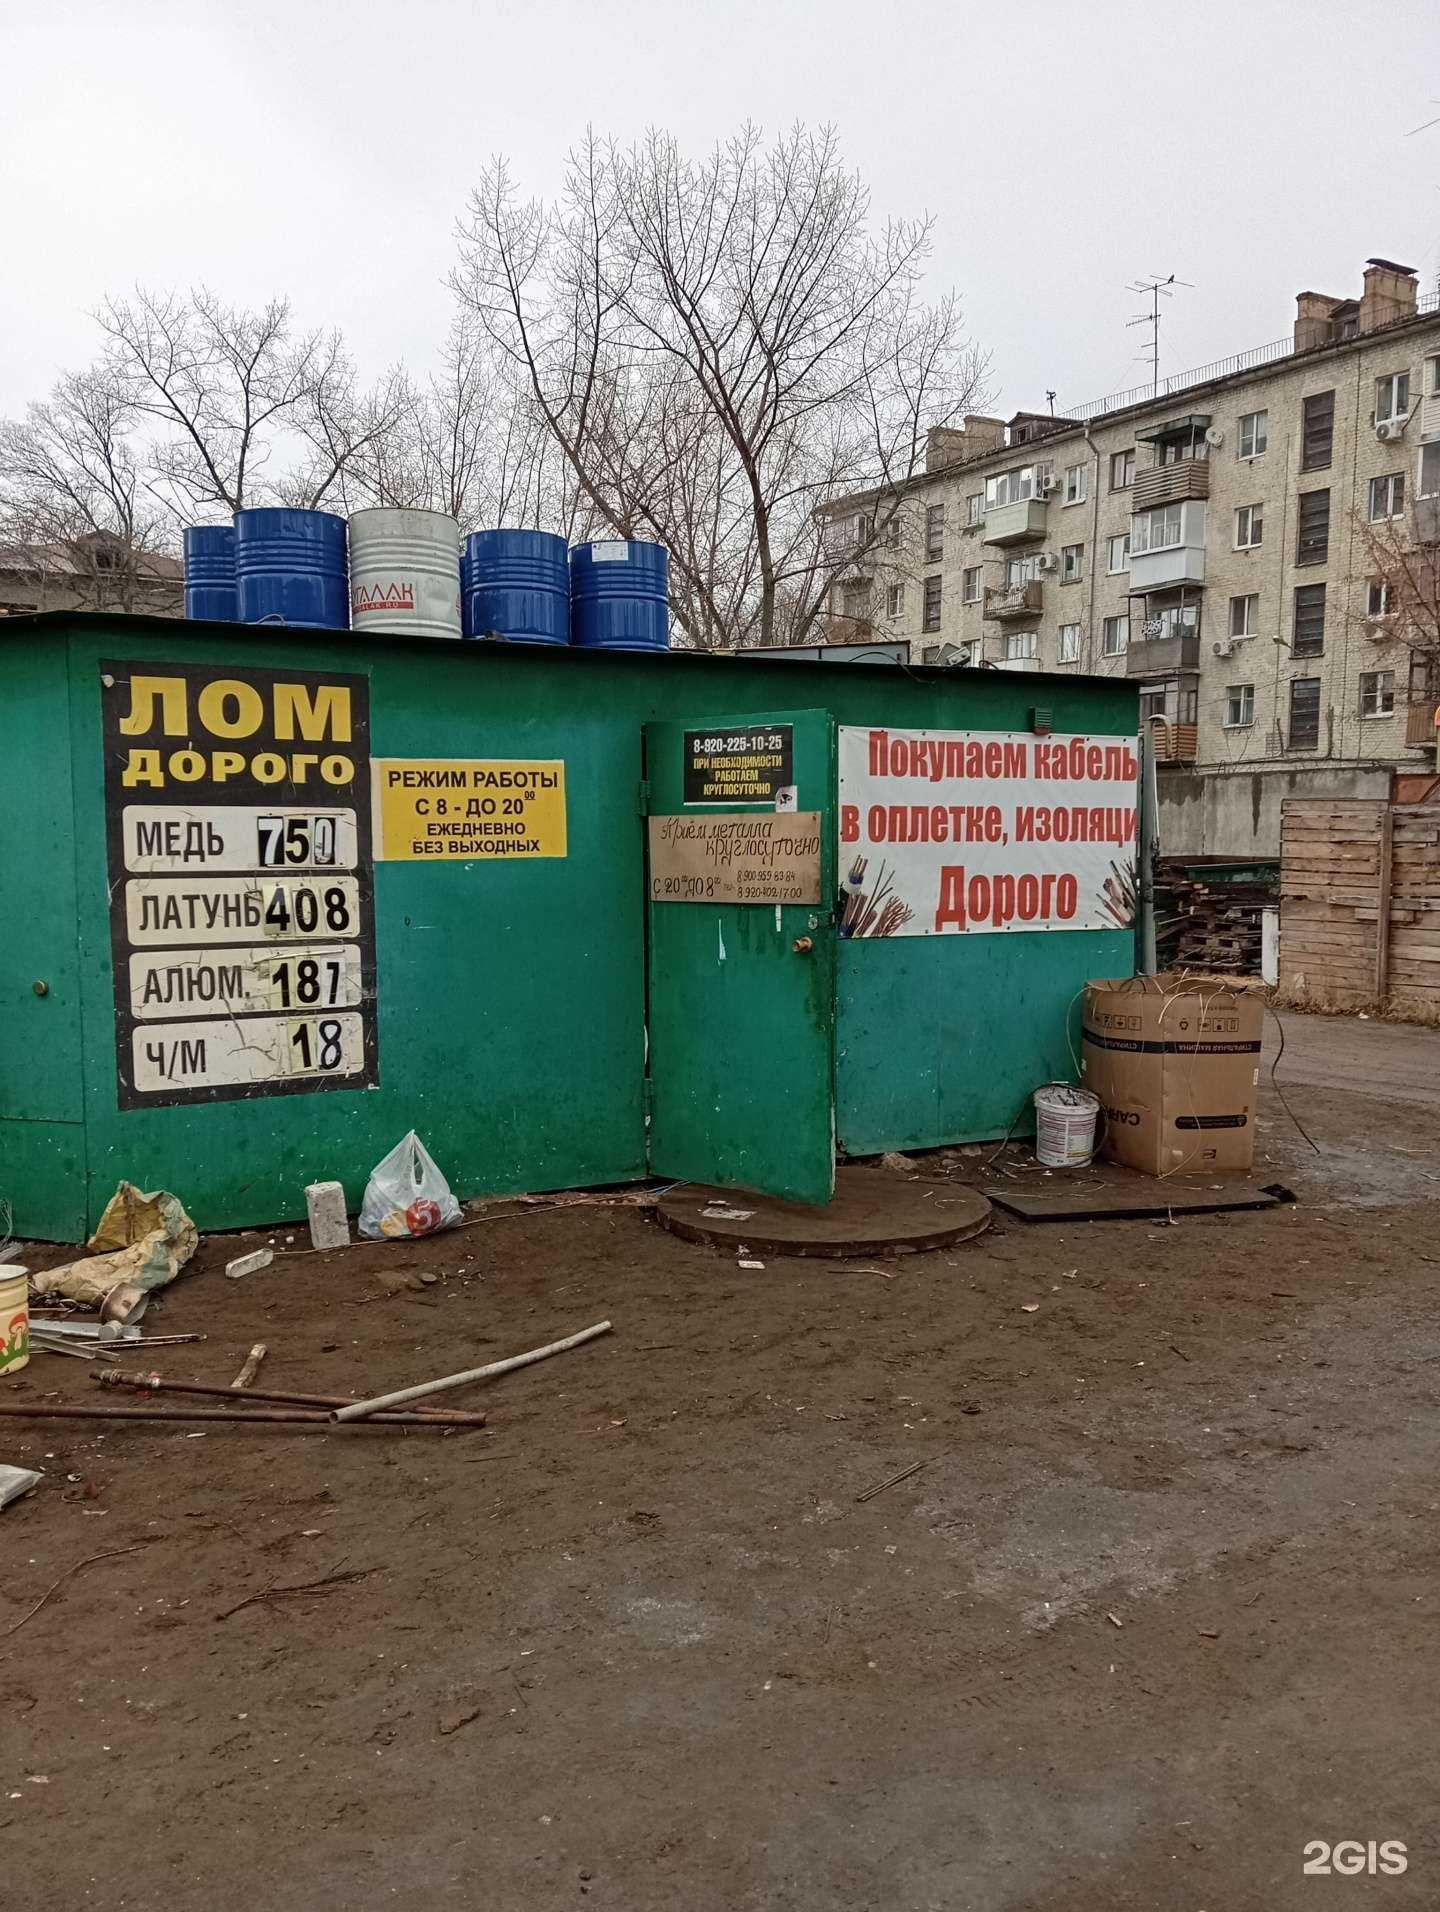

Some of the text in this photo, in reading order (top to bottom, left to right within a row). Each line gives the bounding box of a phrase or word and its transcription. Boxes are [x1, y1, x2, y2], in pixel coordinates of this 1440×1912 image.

[119, 675, 352, 742] ЛОМ
[693, 735, 782, 753] 8-920-225-10-25
[869, 731, 1137, 782] Покупаем кабель
[122, 749, 355, 787] ДОРОГО
[693, 755, 782, 769] ПРИ НЕОБХОДИМОСТИ
[715, 770, 758, 782] РАБОТАЕМ
[388, 771, 558, 788] РЕЖИМ РАБОТЫ
[703, 783, 771, 795] КРУГЛОСУТОЧНО
[415, 799, 430, 815] С
[436, 799, 447, 815] 8
[465, 799, 496, 818] ДО
[427, 823, 526, 838] ЕЖЕДНЕВНО
[708, 822, 773, 839] металла
[841, 805, 860, 842] в
[868, 805, 1008, 846] оплетке,
[136, 817, 335, 866] МЕДЬ 750
[413, 840, 540, 855] БЕЗ ВЫХОДНЫХ
[705, 837, 819, 866] круглосуточно
[139, 887, 350, 932] ЛАТУНЬ 408
[935, 865, 1078, 932] Дорого
[143, 959, 340, 1007] АЛЮМ. 187
[146, 1019, 342, 1077] Ч/М 18
